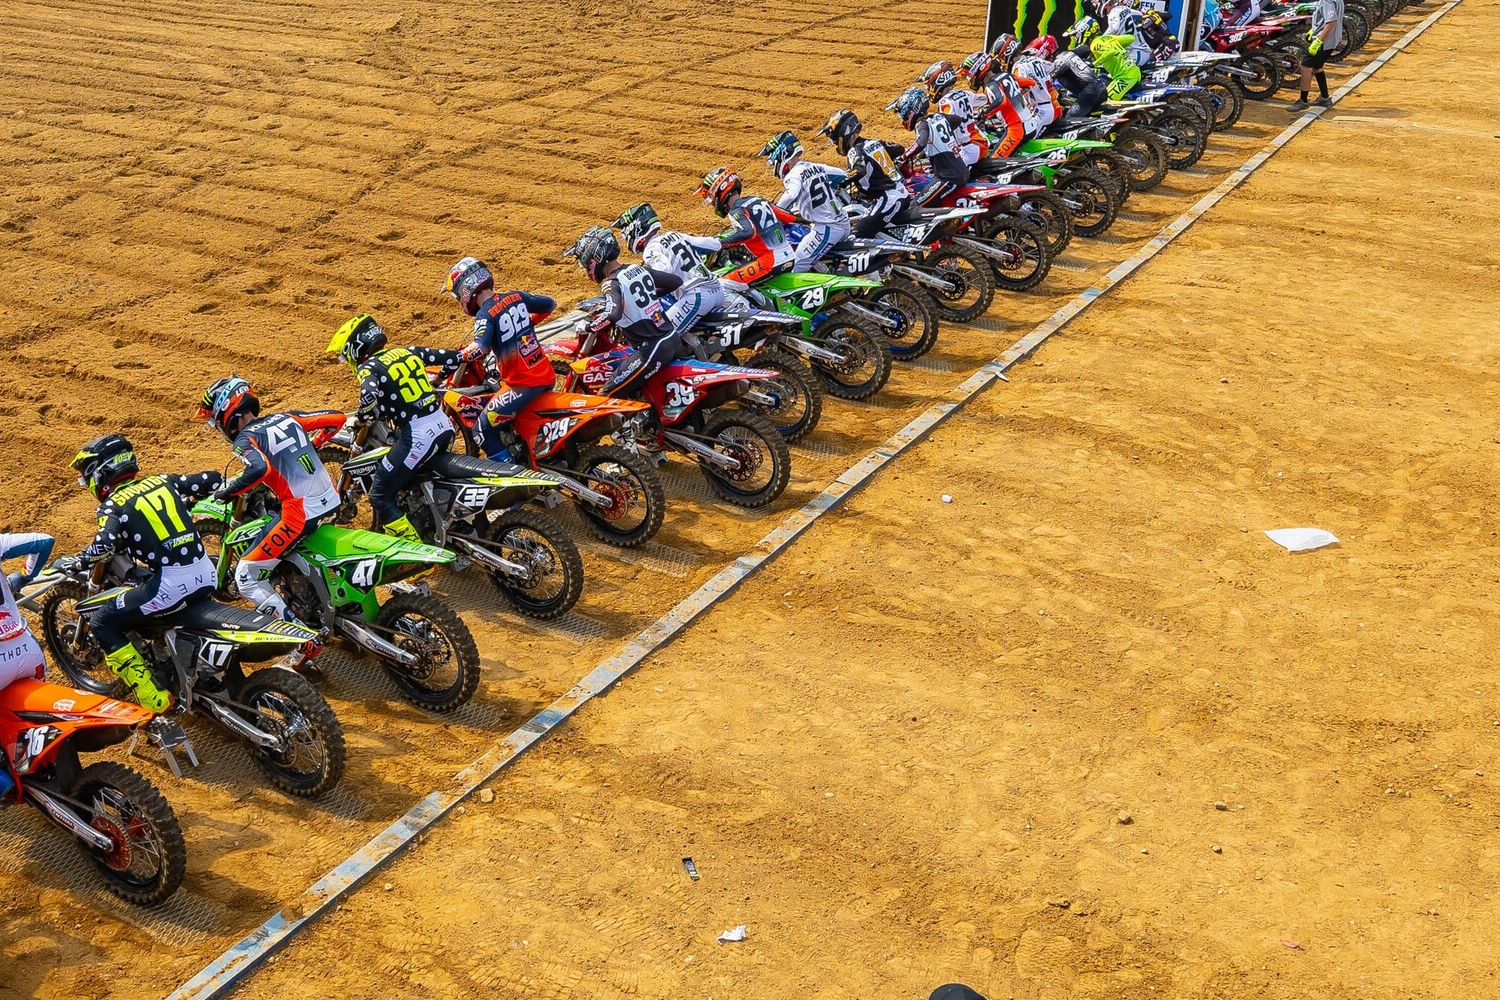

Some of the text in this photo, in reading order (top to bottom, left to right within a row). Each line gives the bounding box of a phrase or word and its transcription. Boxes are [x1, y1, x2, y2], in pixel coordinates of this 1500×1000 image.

[997, 137, 1015, 158] FOX
[902, 226, 926, 242] 24
[737, 262, 765, 281] FOX
[848, 252, 870, 273] 511
[629, 275, 658, 308] 39
[802, 287, 824, 310] 29
[498, 302, 530, 343] 929
[720, 323, 742, 348] 31
[388, 355, 433, 403] 33
[666, 382, 695, 406] 39
[266, 417, 308, 457] 47
[350, 465, 377, 476] TRIUMPH
[463, 488, 490, 507] 33
[134, 486, 187, 542] 17
[261, 524, 296, 557] FOX
[352, 558, 378, 587] 47
[3, 621, 19, 634] Bull
[208, 644, 233, 666] 17
[25, 725, 50, 756] 16
